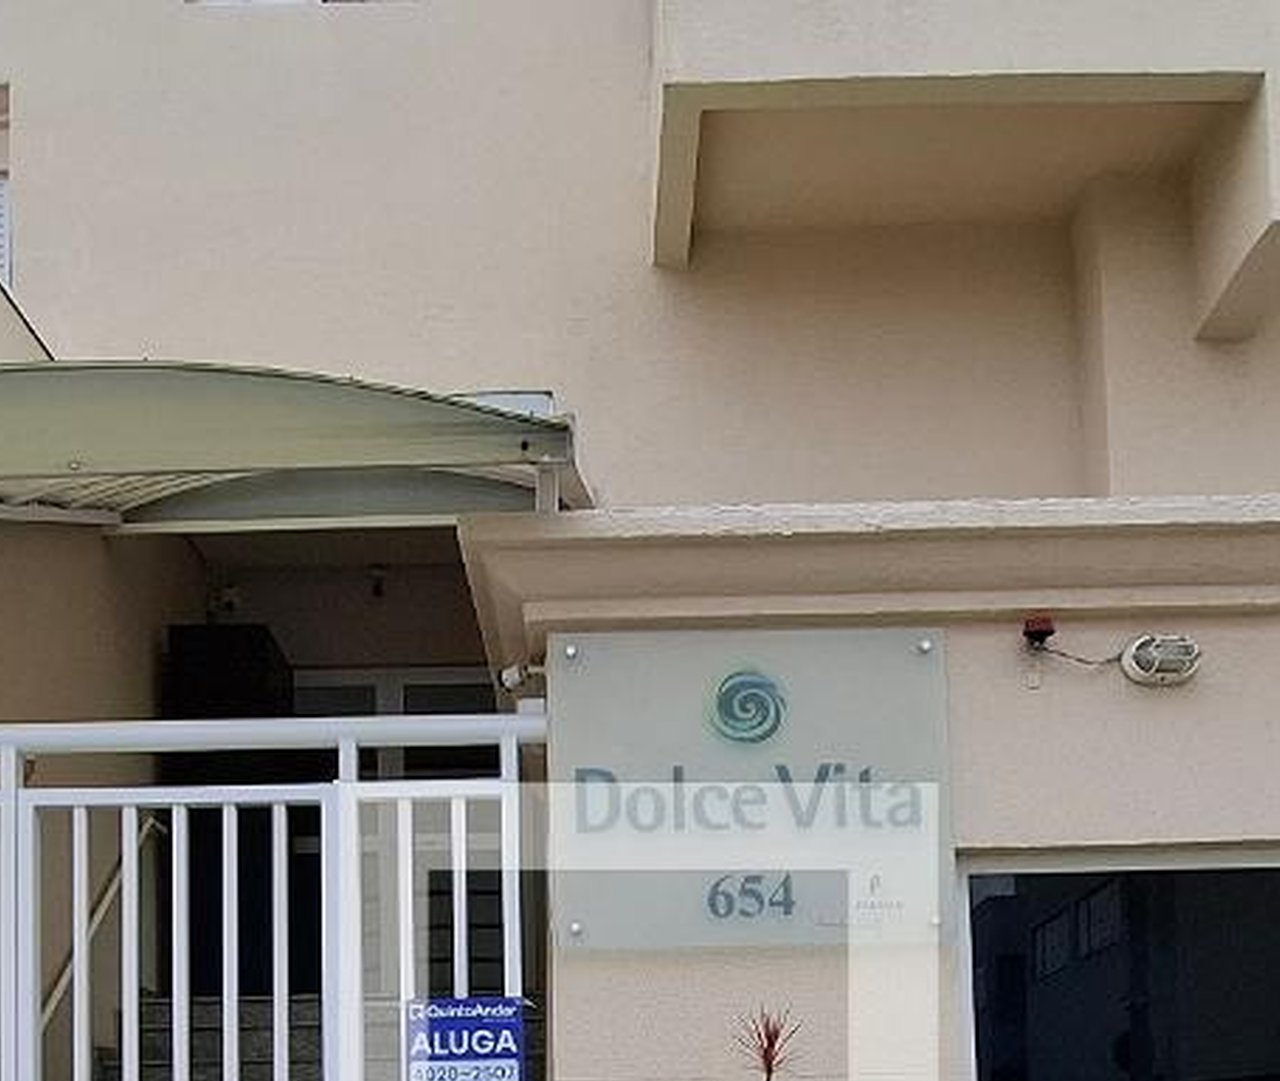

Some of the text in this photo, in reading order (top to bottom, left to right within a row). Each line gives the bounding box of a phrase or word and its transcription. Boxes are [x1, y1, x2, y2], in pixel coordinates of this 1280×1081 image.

[573, 762, 922, 834] Dolce Vita
[707, 871, 797, 919] 654
[409, 1029, 518, 1056] ALUGA
